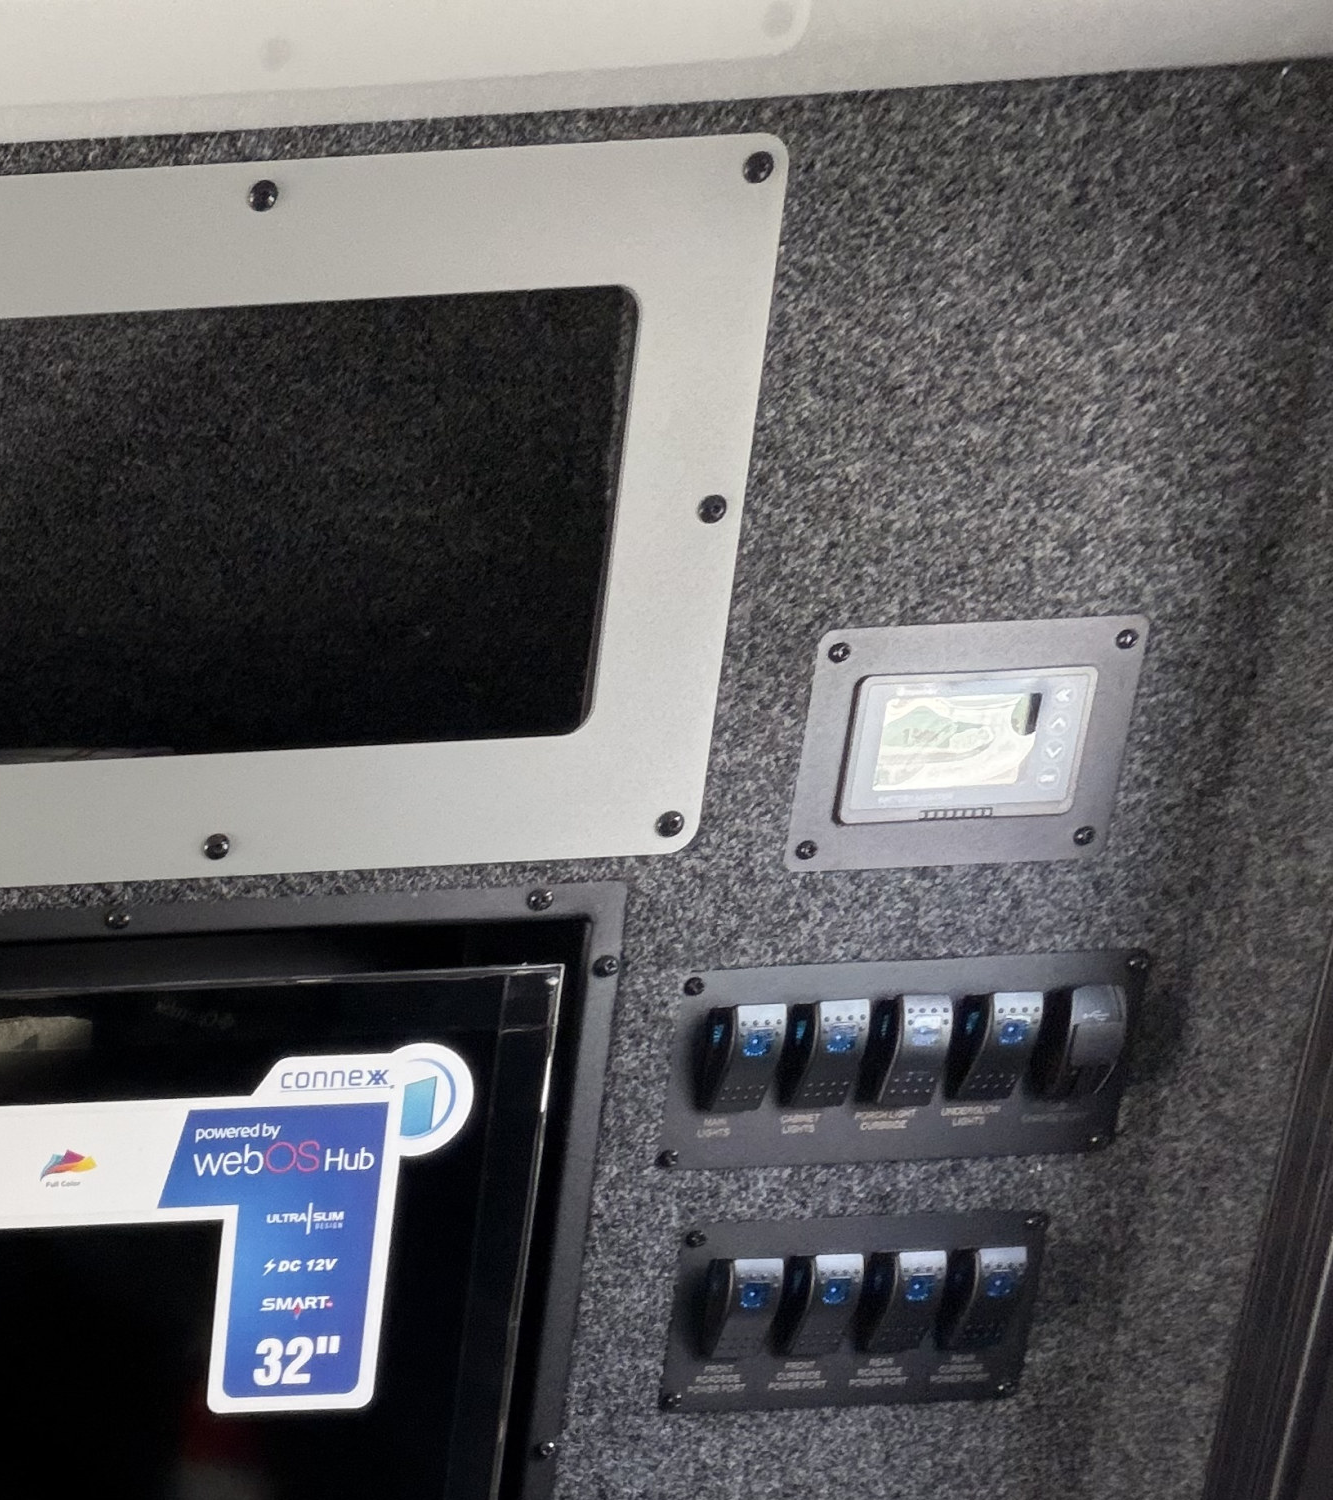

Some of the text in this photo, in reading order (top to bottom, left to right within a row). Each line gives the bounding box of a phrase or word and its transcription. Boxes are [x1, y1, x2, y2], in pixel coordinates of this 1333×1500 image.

[194, 1122, 281, 1143] powered by
[193, 1140, 374, 1177] webOS Hub
[266, 1211, 345, 1224] ULTRA SLIM
[277, 1258, 338, 1272] DC 12V
[259, 1296, 331, 1312] SMART
[253, 1335, 341, 1386] 32"
